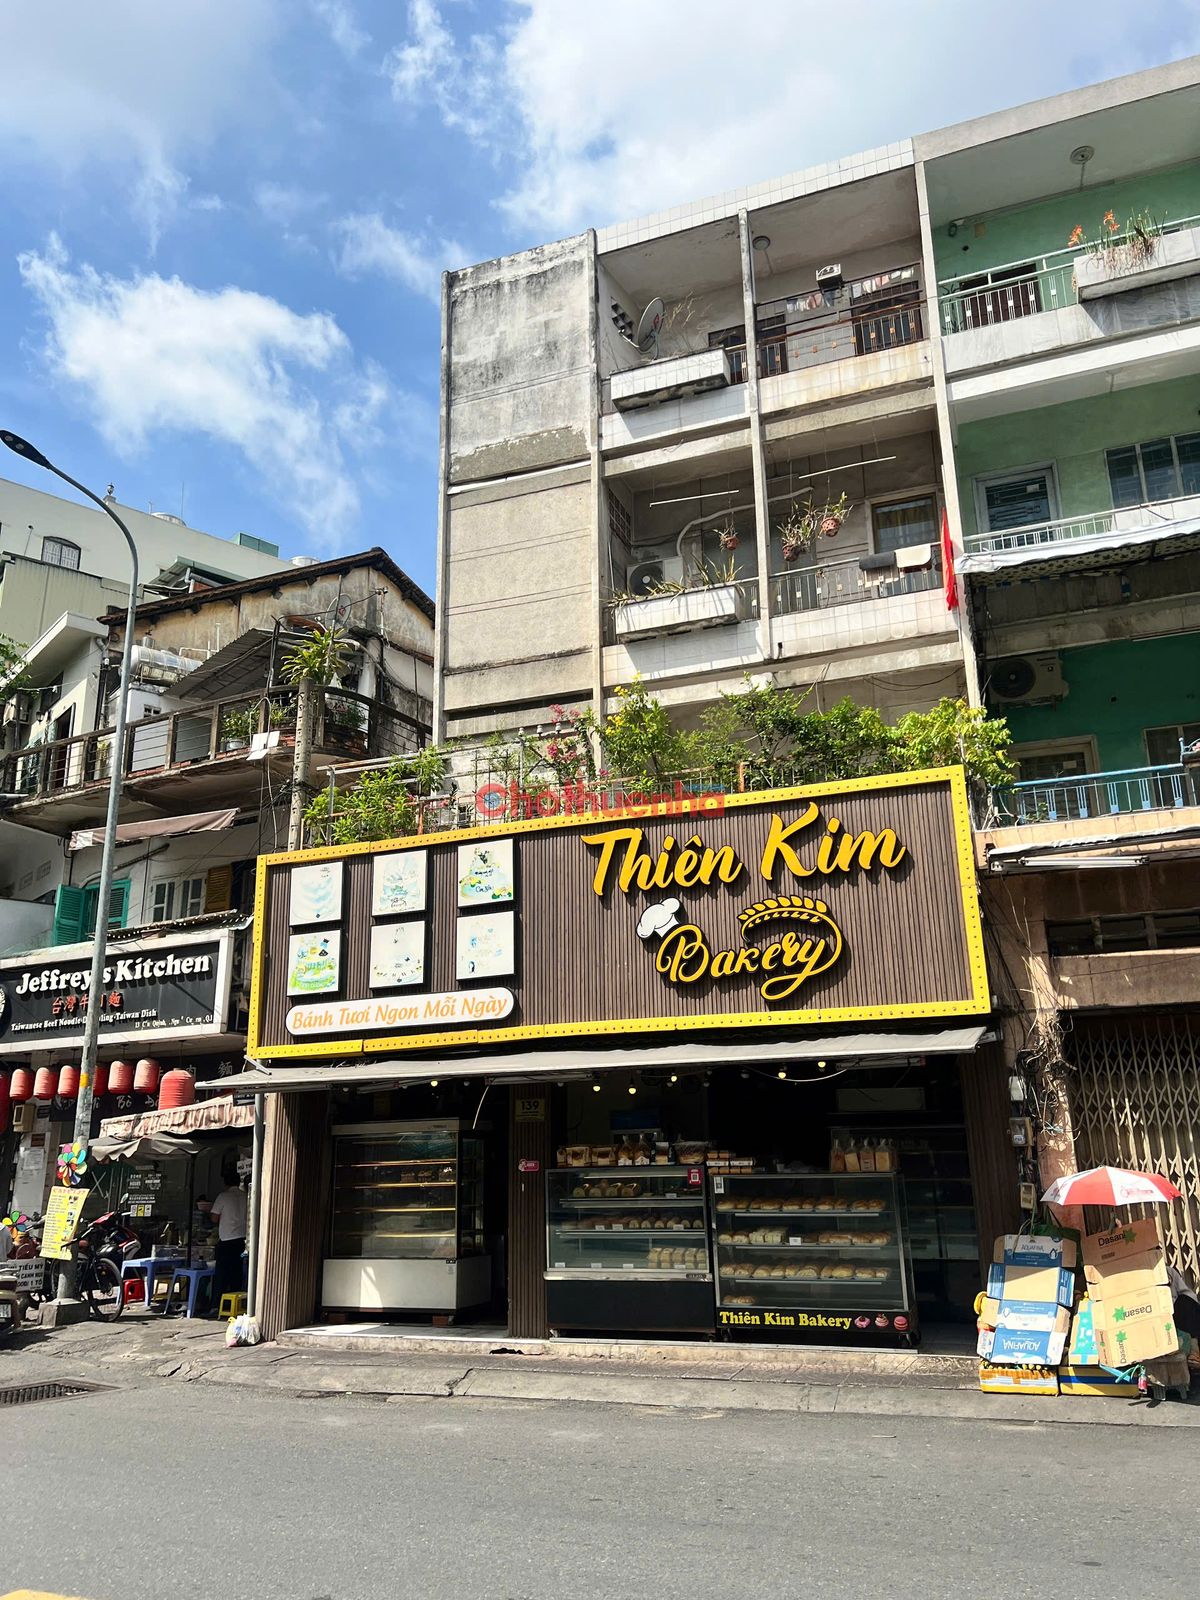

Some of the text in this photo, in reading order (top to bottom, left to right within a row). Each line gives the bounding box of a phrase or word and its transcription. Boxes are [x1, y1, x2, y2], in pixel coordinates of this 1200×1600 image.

[580, 801, 907, 896] Thiên Kim
[15, 954, 209, 995] Jeffreys Kitchen
[655, 918, 843, 1001] Bakery
[52, 990, 121, 1015] 台灣牛麵
[292, 995, 508, 1030] Bánh Tươi Ngon Mỗi Ngày
[521, 1100, 540, 1111] 139
[719, 1311, 852, 1330] Thiên Kim Bakery
[1003, 1338, 1041, 1352] AQUAFINA
